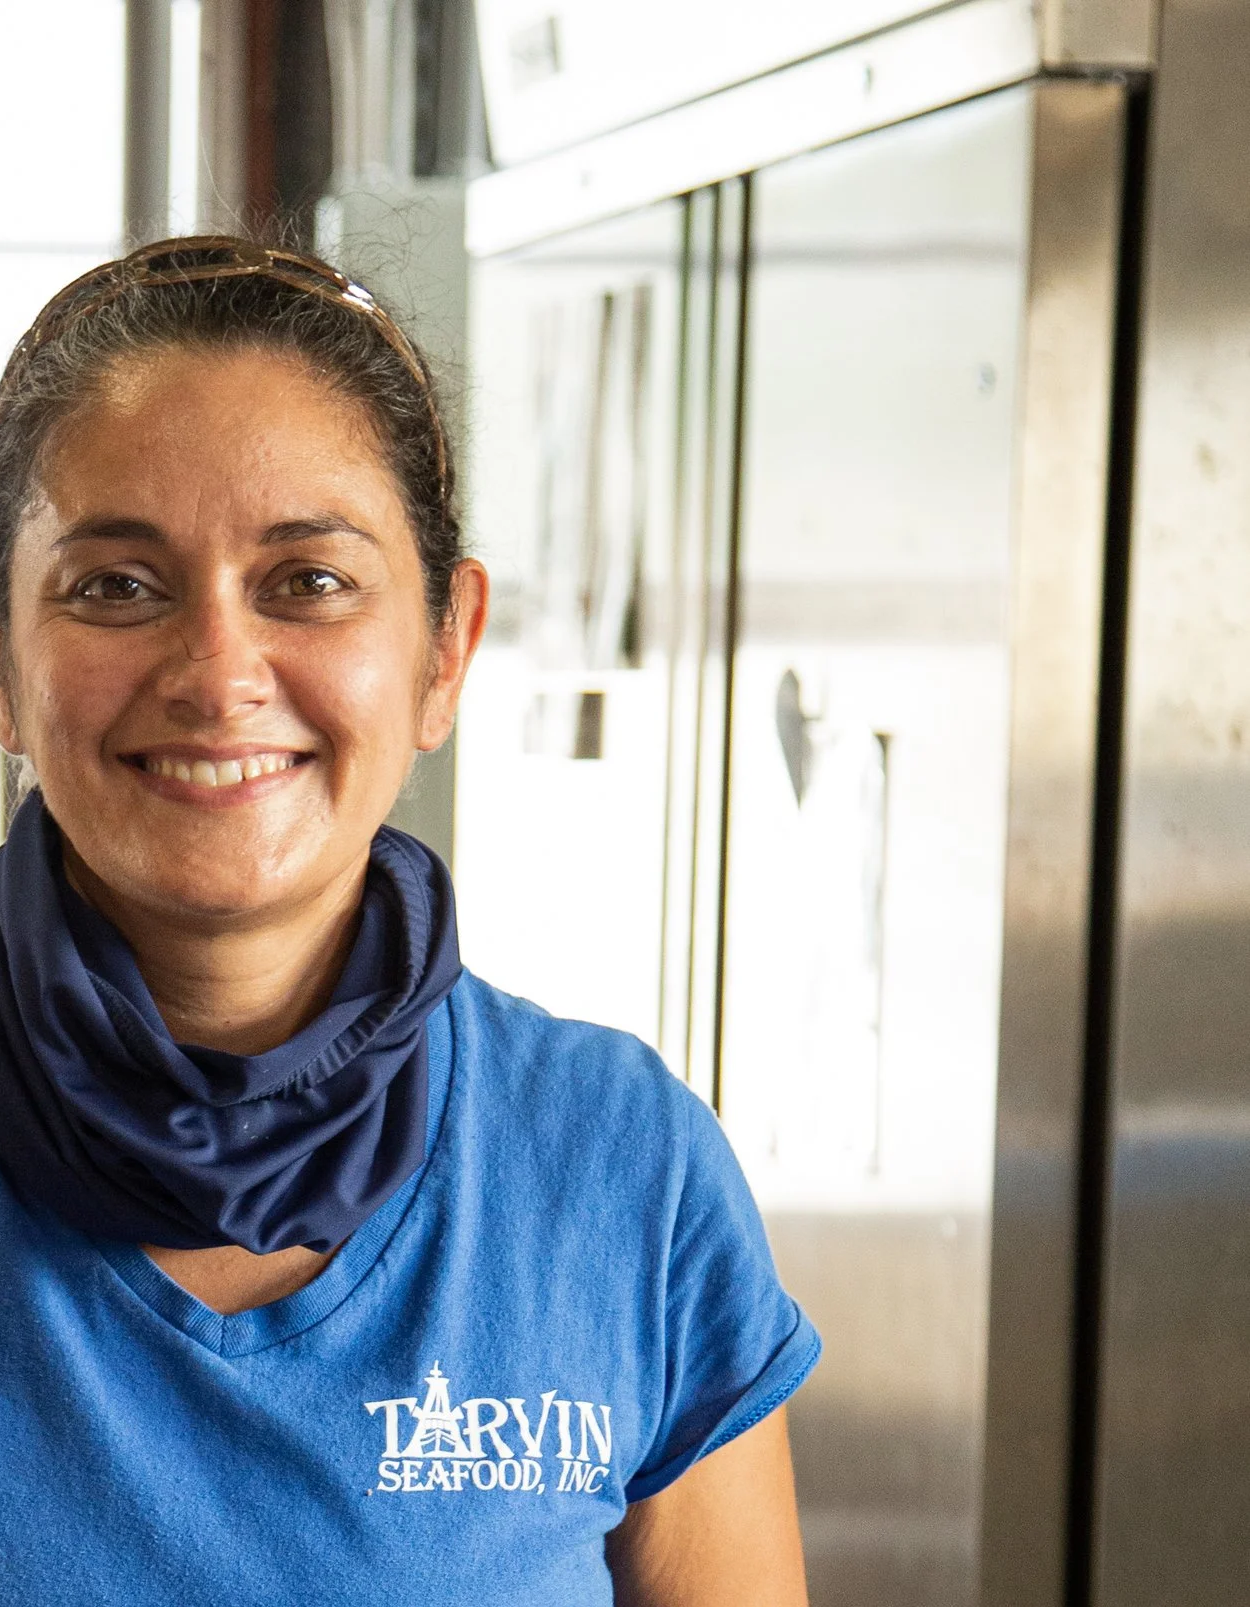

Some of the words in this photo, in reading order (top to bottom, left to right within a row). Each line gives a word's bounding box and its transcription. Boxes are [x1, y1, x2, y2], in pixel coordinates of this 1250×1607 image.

[364, 1360, 612, 1464] TARVIN
[377, 1459, 545, 1495] SEAFOOD,
[556, 1460, 610, 1493] INC
